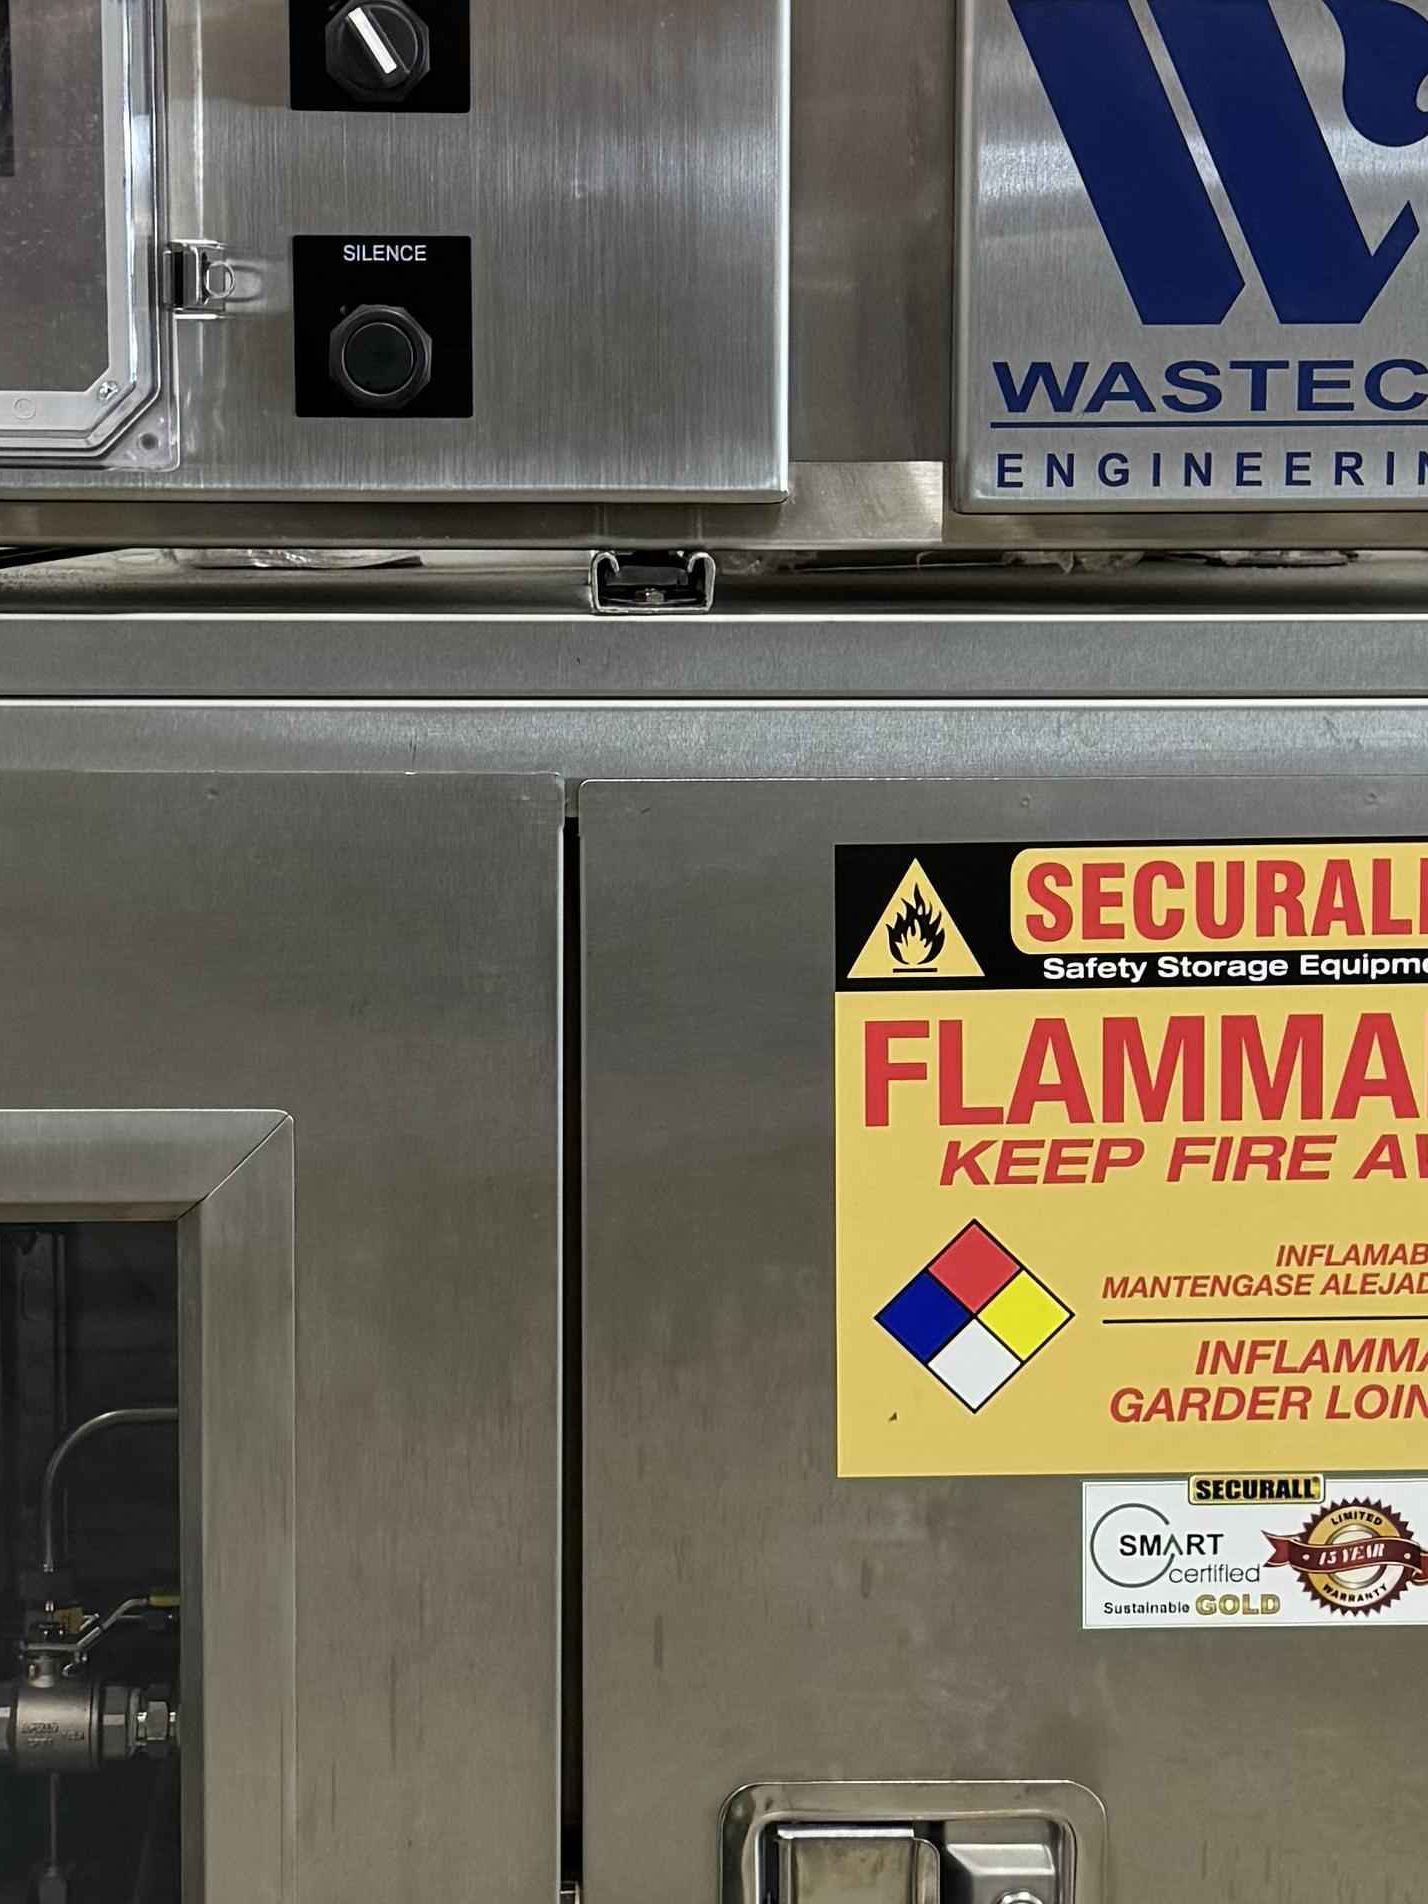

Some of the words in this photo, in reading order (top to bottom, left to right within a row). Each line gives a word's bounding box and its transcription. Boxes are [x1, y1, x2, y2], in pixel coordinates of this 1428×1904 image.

[342, 244, 428, 262] SILENCE
[1042, 954, 1147, 984] Safety
[1157, 953, 1289, 983] Storage
[939, 1137, 1144, 1186] KEEP
[1166, 1133, 1337, 1183] FIRE
[1102, 1273, 1315, 1300] MANTENGASE
[1109, 1385, 1309, 1424] GARDER
[1195, 1478, 1316, 1500] SECURALL
[1331, 1510, 1383, 1526] LIMITED
[1119, 1533, 1224, 1557] SMART
[1342, 1543, 1385, 1563] YEAR
[1168, 1563, 1261, 1585] certified
[1323, 1582, 1388, 1603] WARRANTY
[1104, 1601, 1190, 1616] Sustainable
[1195, 1594, 1281, 1616] GOLD
